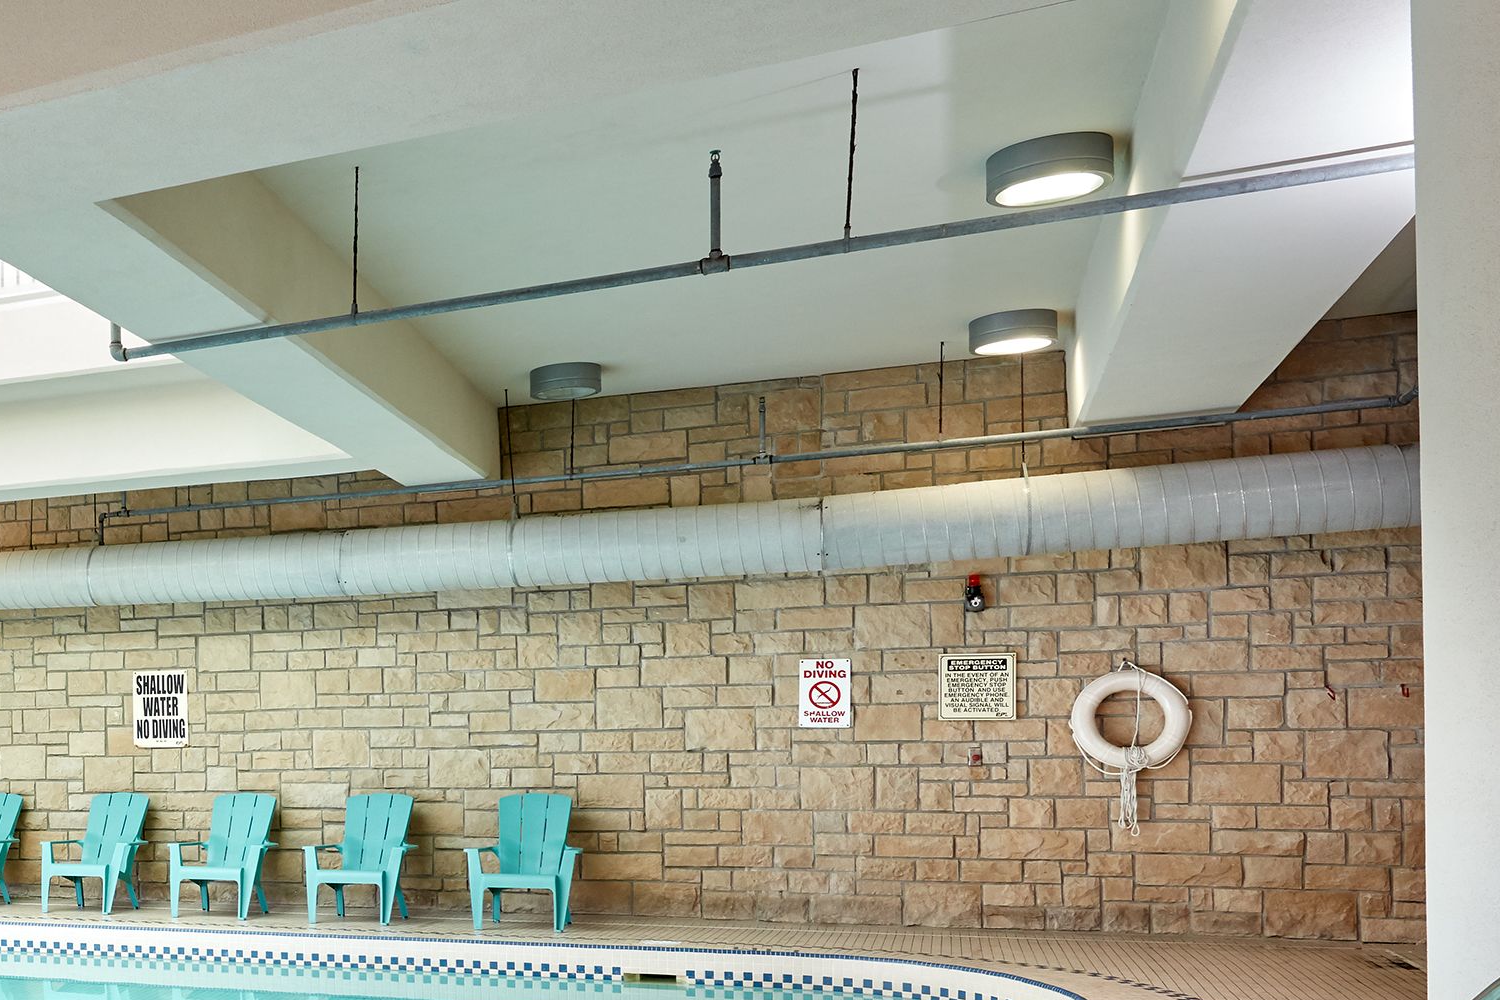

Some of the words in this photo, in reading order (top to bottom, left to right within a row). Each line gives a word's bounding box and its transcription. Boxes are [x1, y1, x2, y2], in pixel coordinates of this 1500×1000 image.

[804, 670, 846, 678] DIVING
[816, 661, 834, 669] NO
[136, 674, 184, 695] SHALLOW
[143, 696, 178, 717] WATER
[137, 719, 149, 739] NO
[152, 719, 185, 738] DIVING
